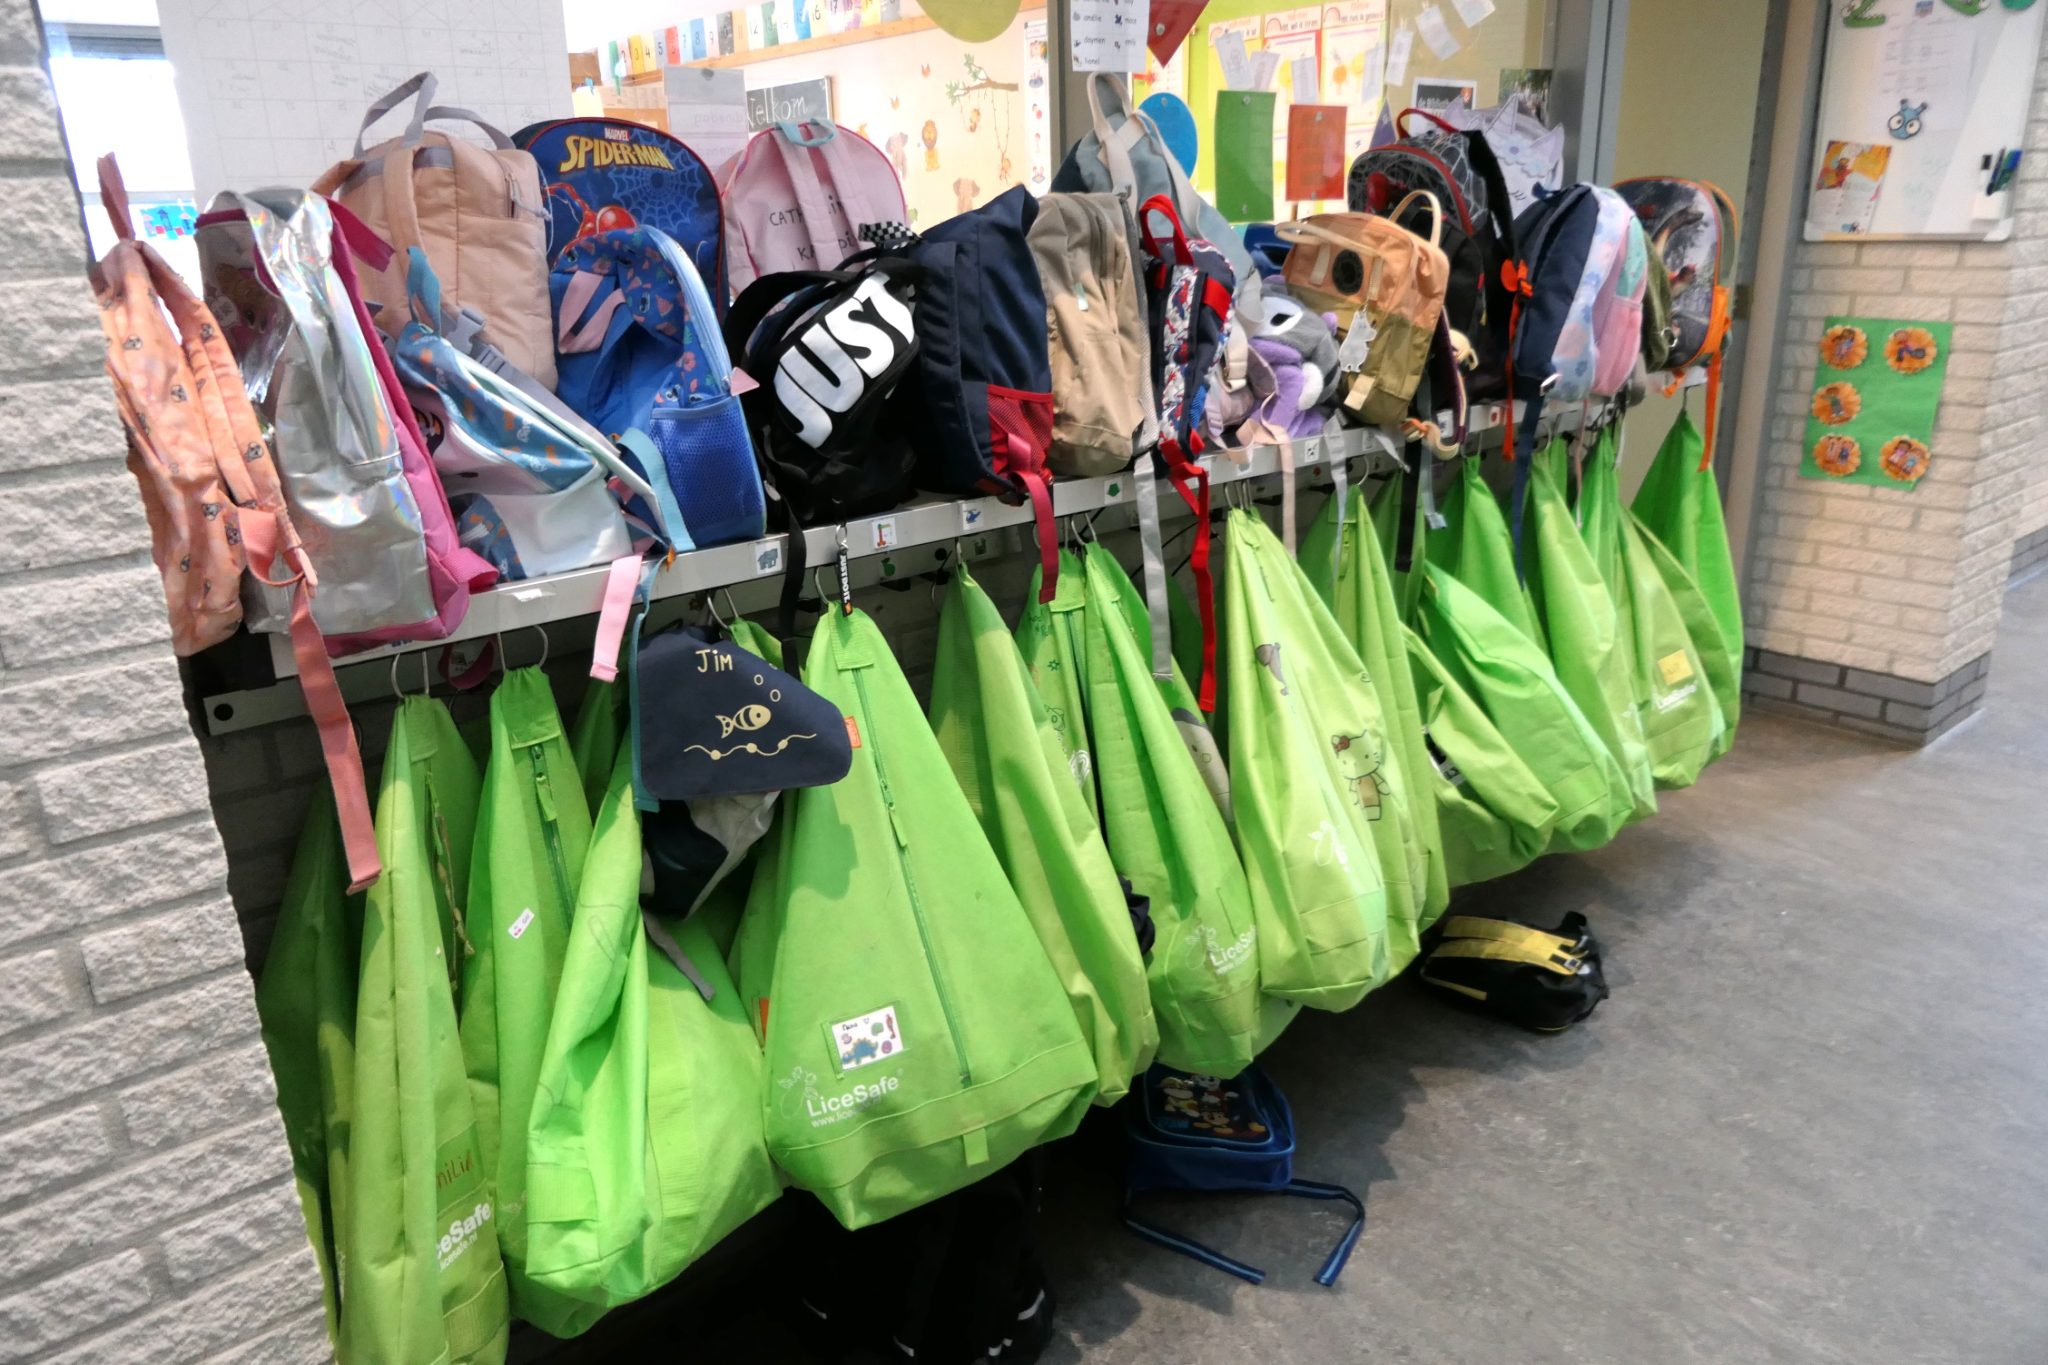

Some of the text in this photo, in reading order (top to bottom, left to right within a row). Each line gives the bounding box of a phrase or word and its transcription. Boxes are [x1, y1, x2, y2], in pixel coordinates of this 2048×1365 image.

[560, 135, 675, 174] SPIDER-MAN
[604, 127, 631, 142] MARVEL
[773, 271, 915, 449] JUST
[807, 1076, 900, 1117] LiceSafe
